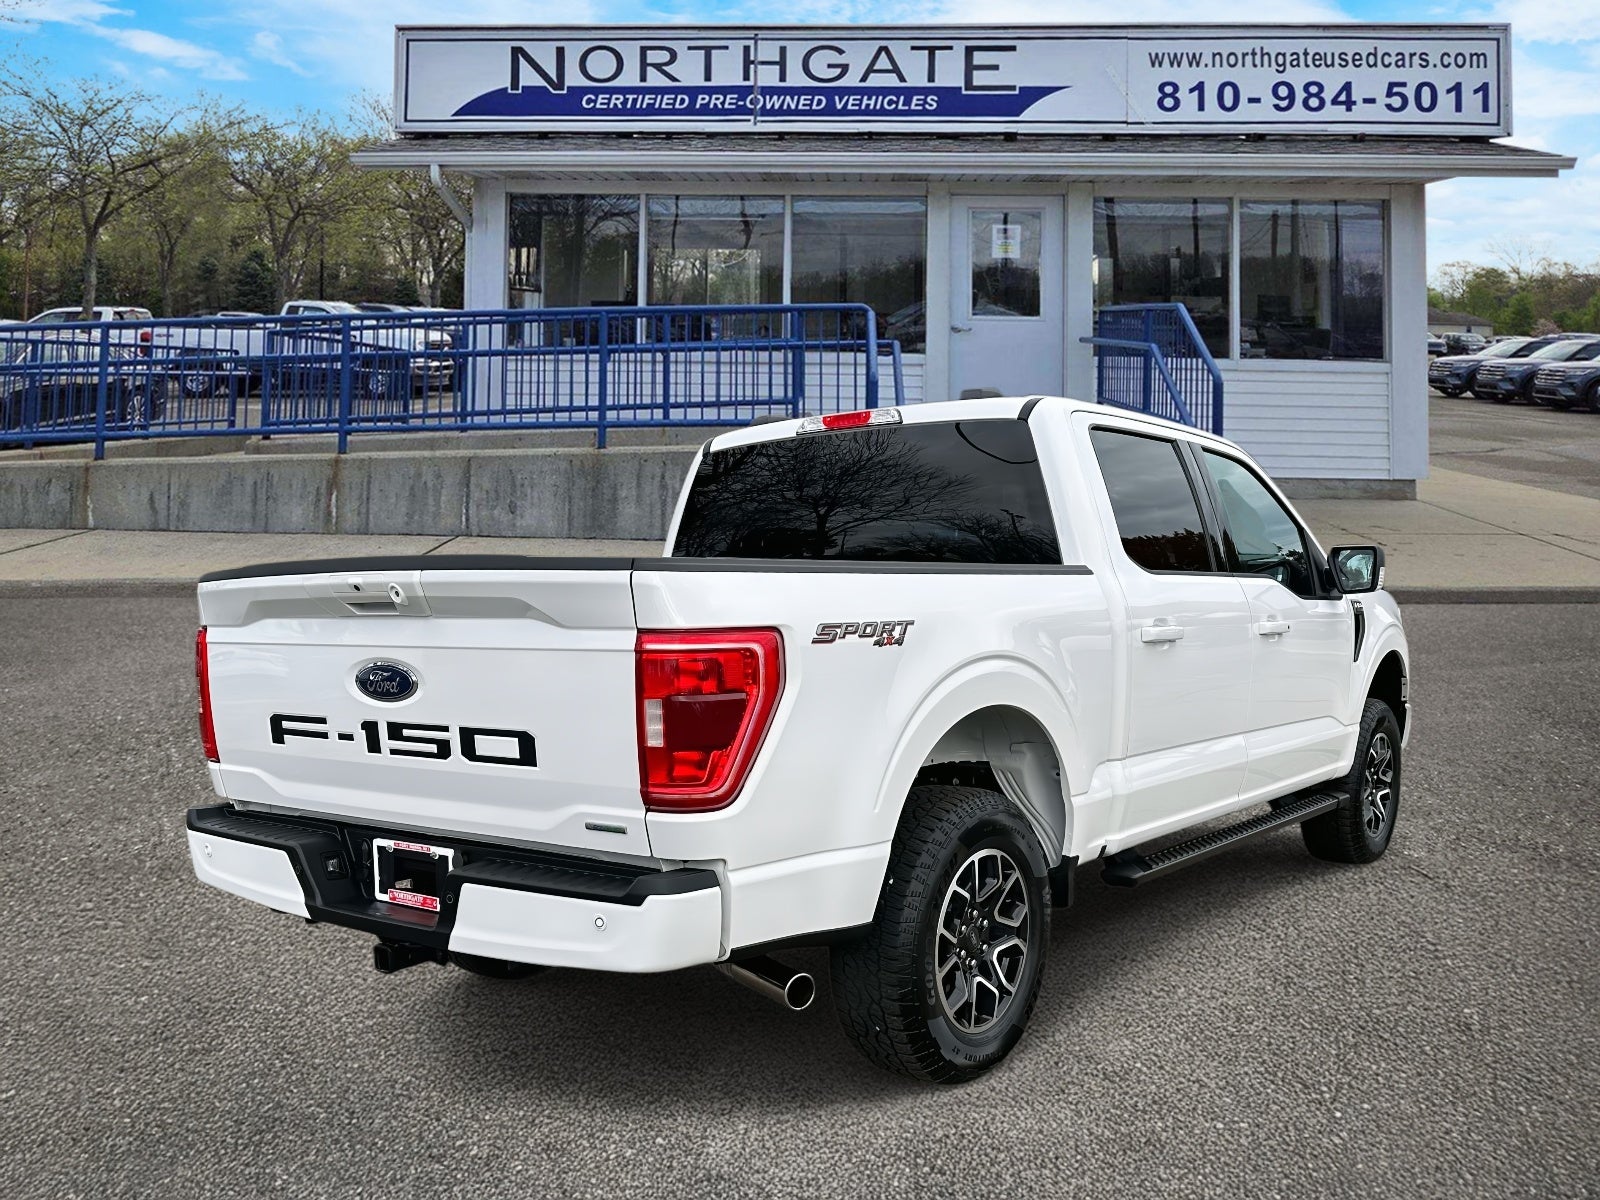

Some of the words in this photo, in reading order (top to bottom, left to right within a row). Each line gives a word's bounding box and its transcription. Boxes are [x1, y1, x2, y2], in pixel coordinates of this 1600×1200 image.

[509, 44, 1017, 93] NORTHGATE
[1148, 46, 1488, 73] www.northgateusedcars.com
[581, 94, 690, 110] CERTIFIED
[695, 94, 827, 111] PRE-OWNED
[834, 94, 939, 111] VEHICLES
[1156, 80, 1491, 113] 810-984-5011
[811, 619, 915, 645] SPORT
[366, 670, 400, 693] Ford
[268, 712, 539, 768] F-150
